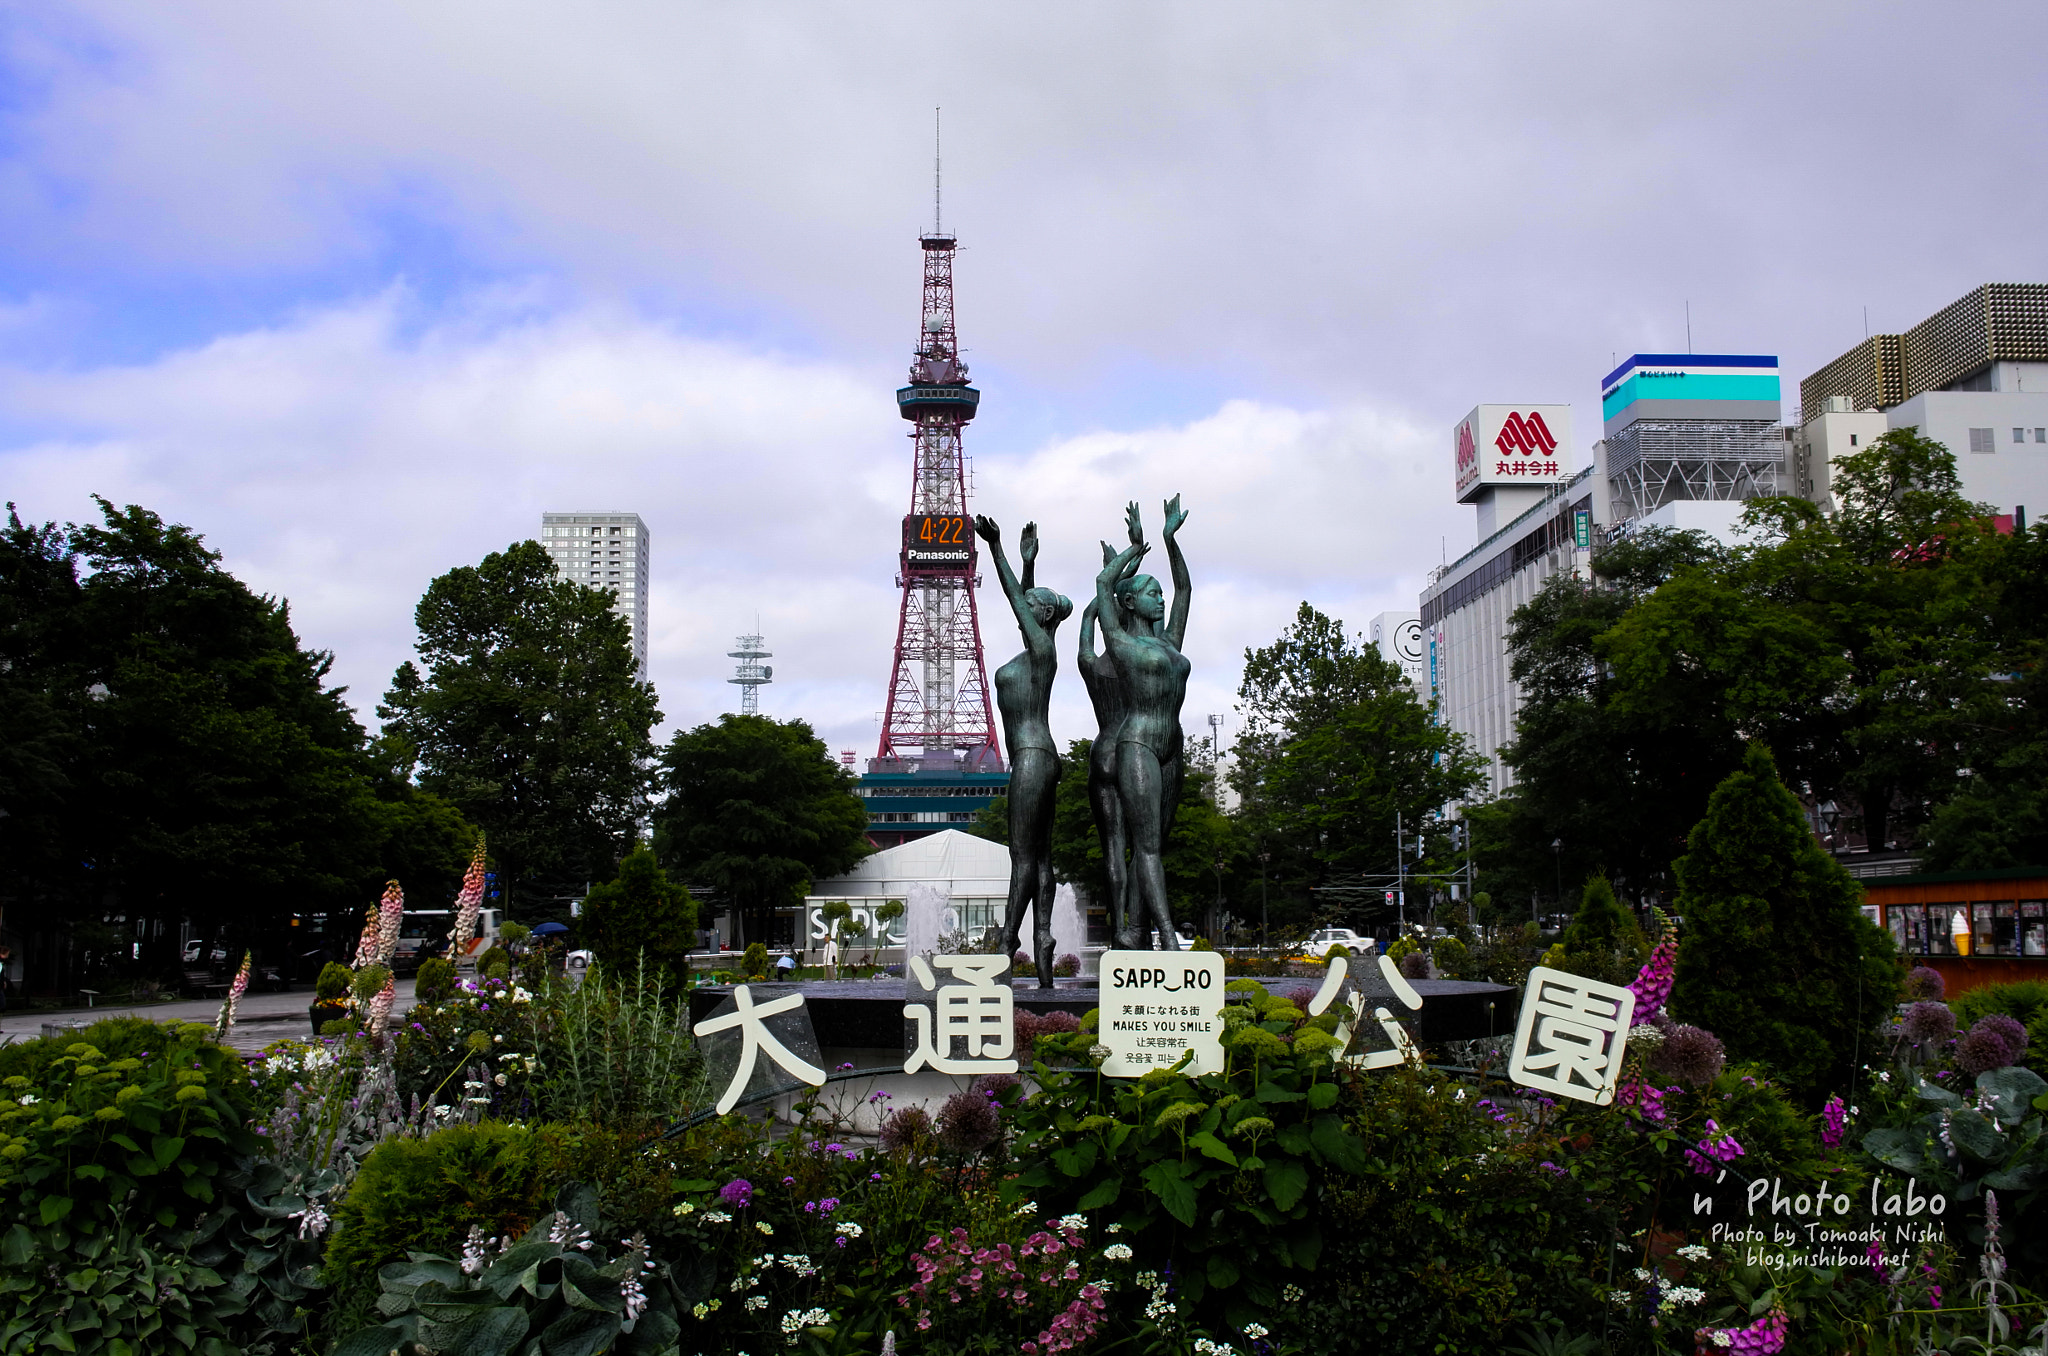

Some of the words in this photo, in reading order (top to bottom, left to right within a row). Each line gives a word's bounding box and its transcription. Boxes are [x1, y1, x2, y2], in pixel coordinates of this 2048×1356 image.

[1496, 460, 1559, 476] 丸井今井
[920, 517, 964, 544] 4:22
[908, 550, 969, 560] Panasonic
[1122, 1004, 1200, 1016] 笑顔になれる街
[1113, 1021, 1148, 1031] MAKES
[1153, 1021, 1176, 1032] YOU
[1180, 1021, 1211, 1032] SMILE
[1136, 1037, 1188, 1048] 让笑容常在
[1125, 1052, 1153, 1064] 웃음꽃
[1157, 1053, 1176, 1064] 피는
